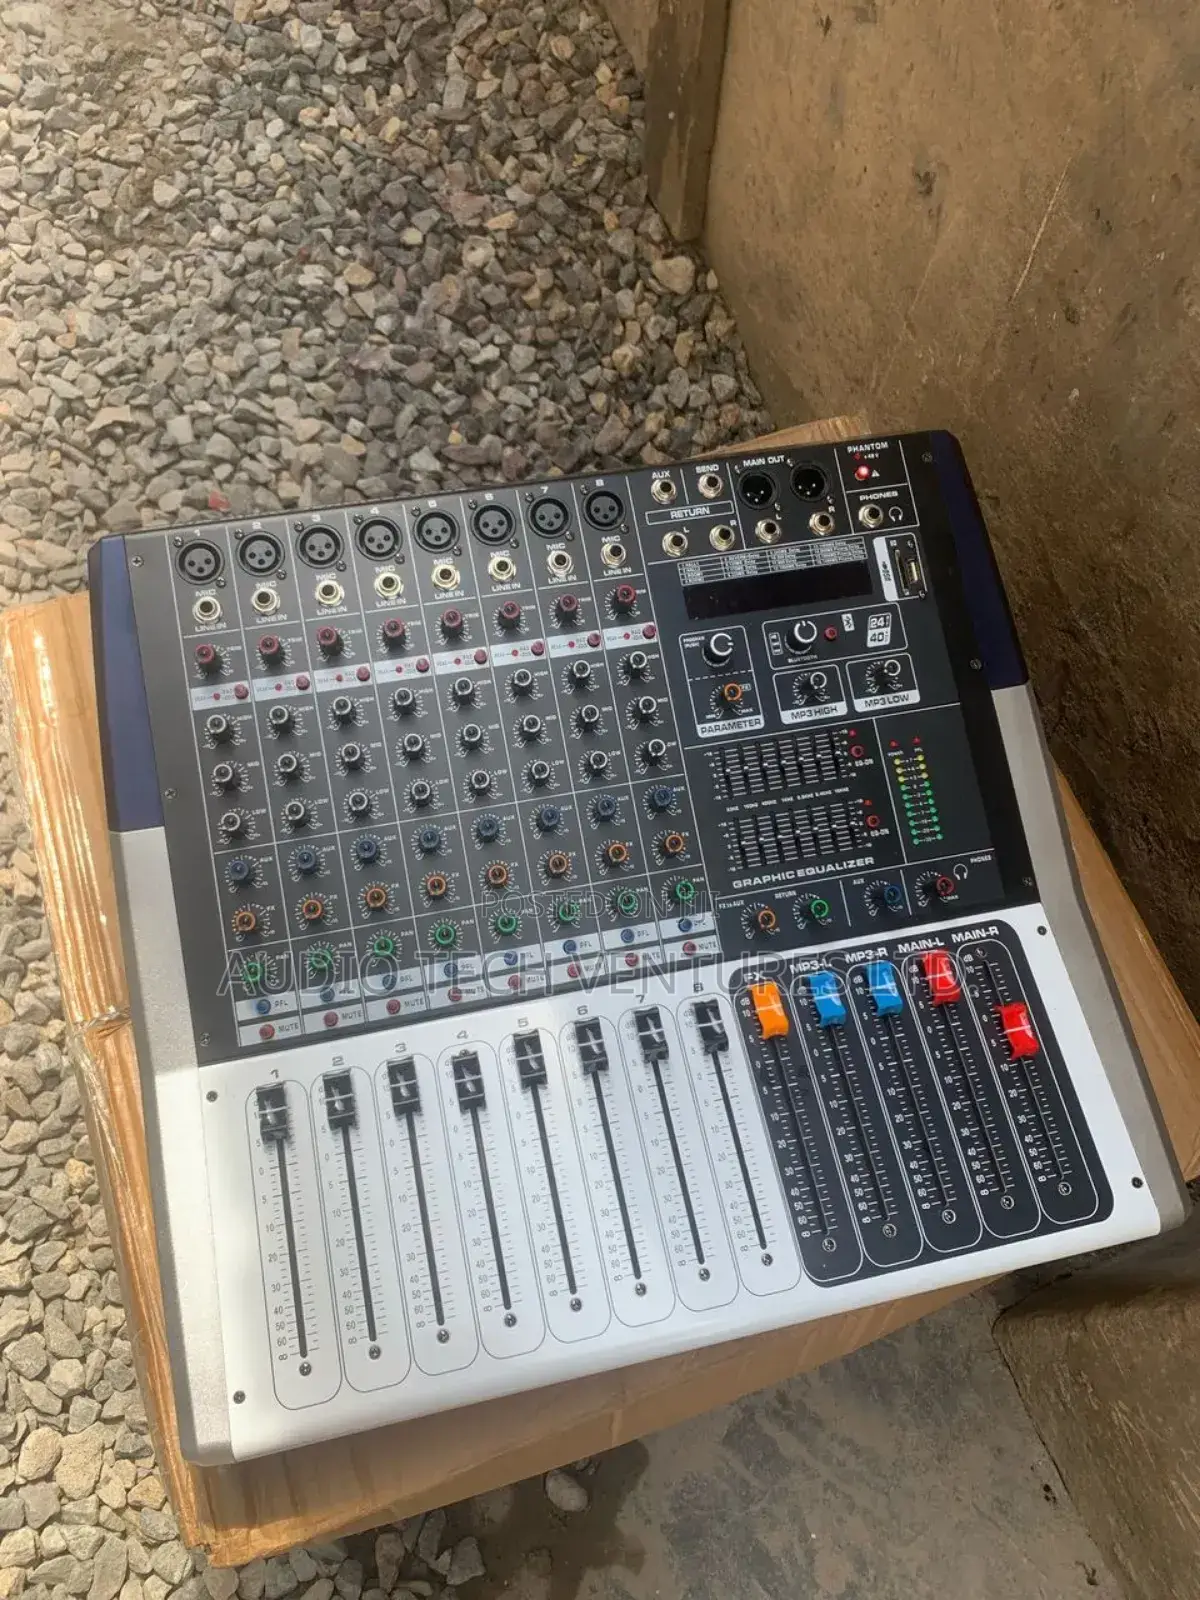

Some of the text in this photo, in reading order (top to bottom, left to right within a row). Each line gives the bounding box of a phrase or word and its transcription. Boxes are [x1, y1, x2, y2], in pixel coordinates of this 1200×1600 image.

[847, 442, 888, 452] PHANTOM
[743, 455, 785, 467] MAIN OUT
[652, 470, 670, 479] AUX
[696, 464, 720, 474] SEND
[540, 486, 548, 494] 7
[860, 490, 898, 500] PHONES
[670, 506, 710, 519] RETURN
[870, 616, 885, 628] 24
[870, 632, 885, 642] 40
[865, 694, 910, 708] MP3 LOW
[791, 705, 838, 720] MP3 HIGH
[700, 718, 760, 733] PARAMETER
[732, 856, 876, 889] GRAPHIC EQUALIZER
[951, 925, 1000, 943] MAIN-R
[897, 937, 945, 953] MAIN-L
[845, 947, 888, 964] MP3-R
[790, 959, 833, 974] MP3-L
[744, 972, 766, 982] FX
[693, 982, 705, 994] 8
[404, 998, 424, 1007] MUTE
[636, 994, 645, 1004] 7
[342, 1010, 362, 1020] MUTE
[576, 1004, 589, 1016] 6
[278, 1022, 299, 1032] MUTE
[517, 1017, 530, 1028] 5
[456, 1030, 469, 1040] 4
[395, 1042, 408, 1053] 3
[332, 1055, 344, 1066] 2
[270, 1068, 280, 1079] 1
